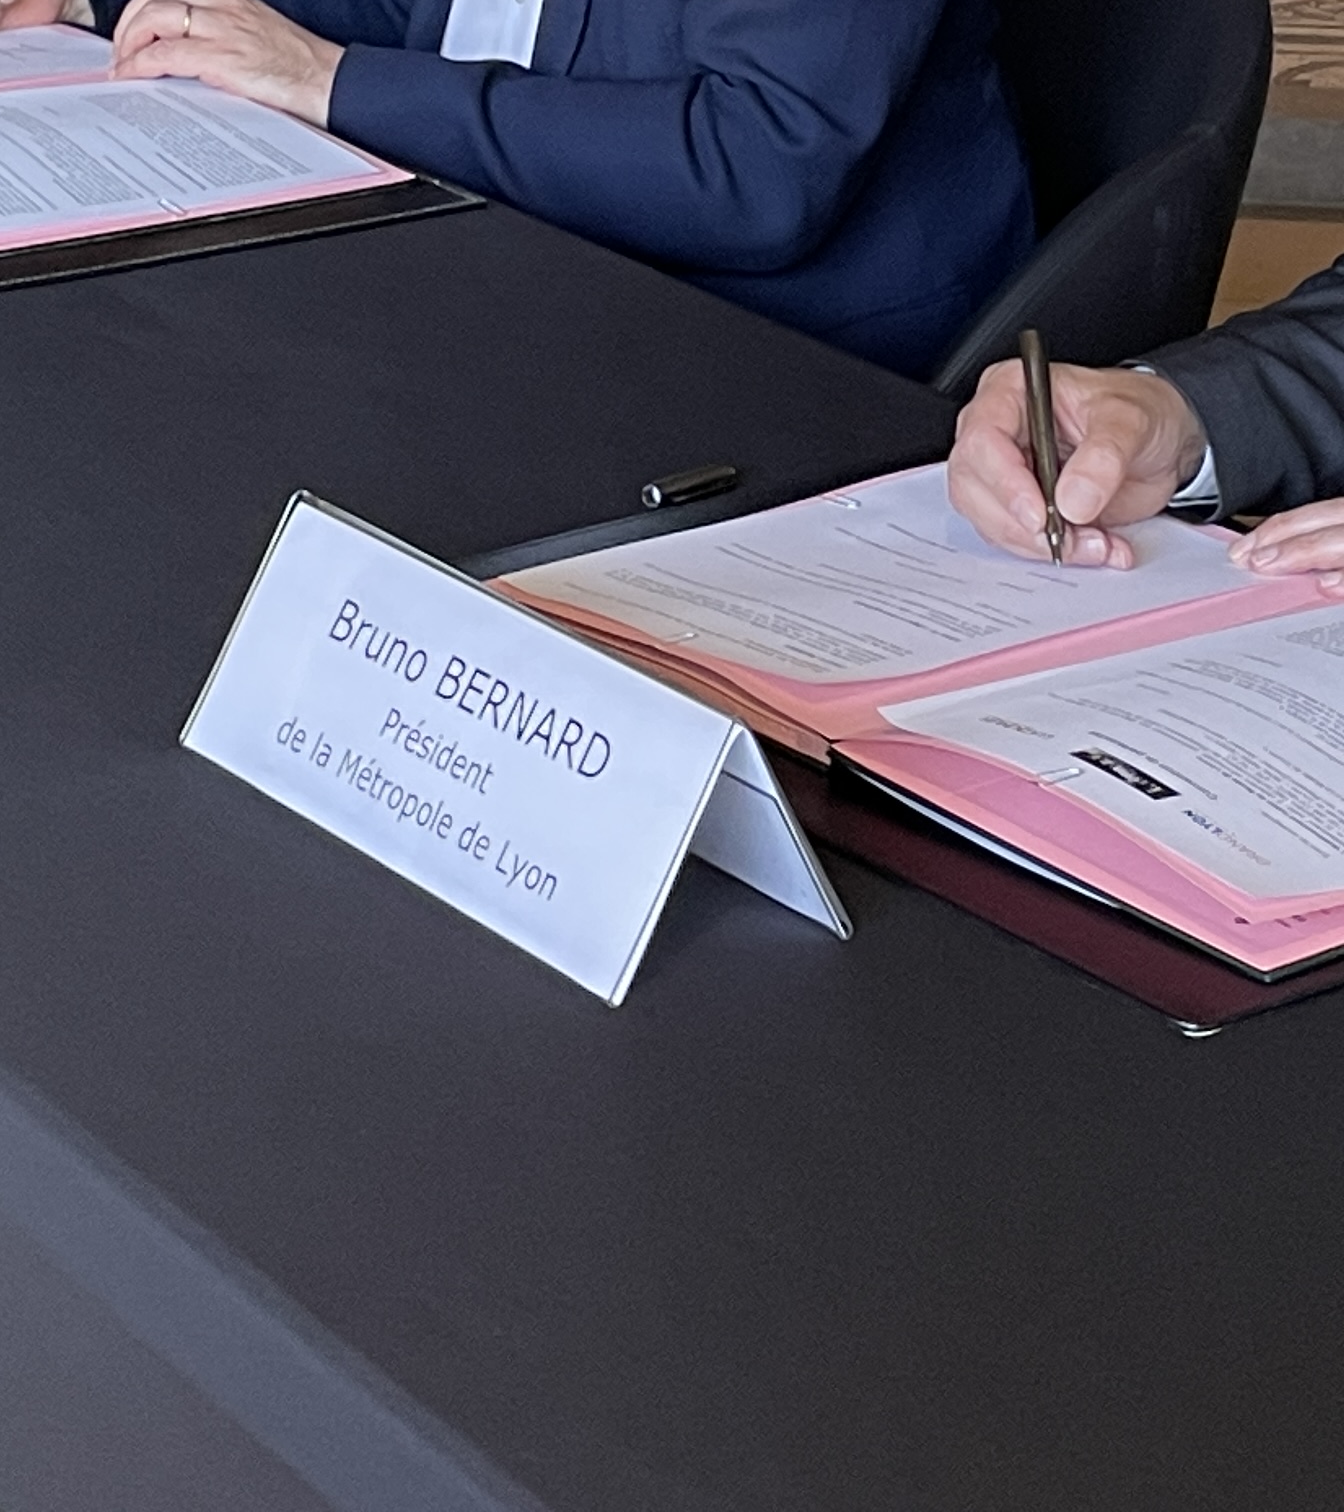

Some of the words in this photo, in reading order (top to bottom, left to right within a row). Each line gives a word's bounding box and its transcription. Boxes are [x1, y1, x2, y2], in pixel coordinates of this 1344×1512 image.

[328, 598, 428, 682] Bruno
[434, 654, 611, 778] BERNARD
[378, 707, 495, 795] Président
[276, 716, 307, 754] de
[309, 731, 333, 768] la
[335, 748, 454, 840] Métropole
[457, 820, 491, 861] de
[494, 839, 558, 901] Lyon
